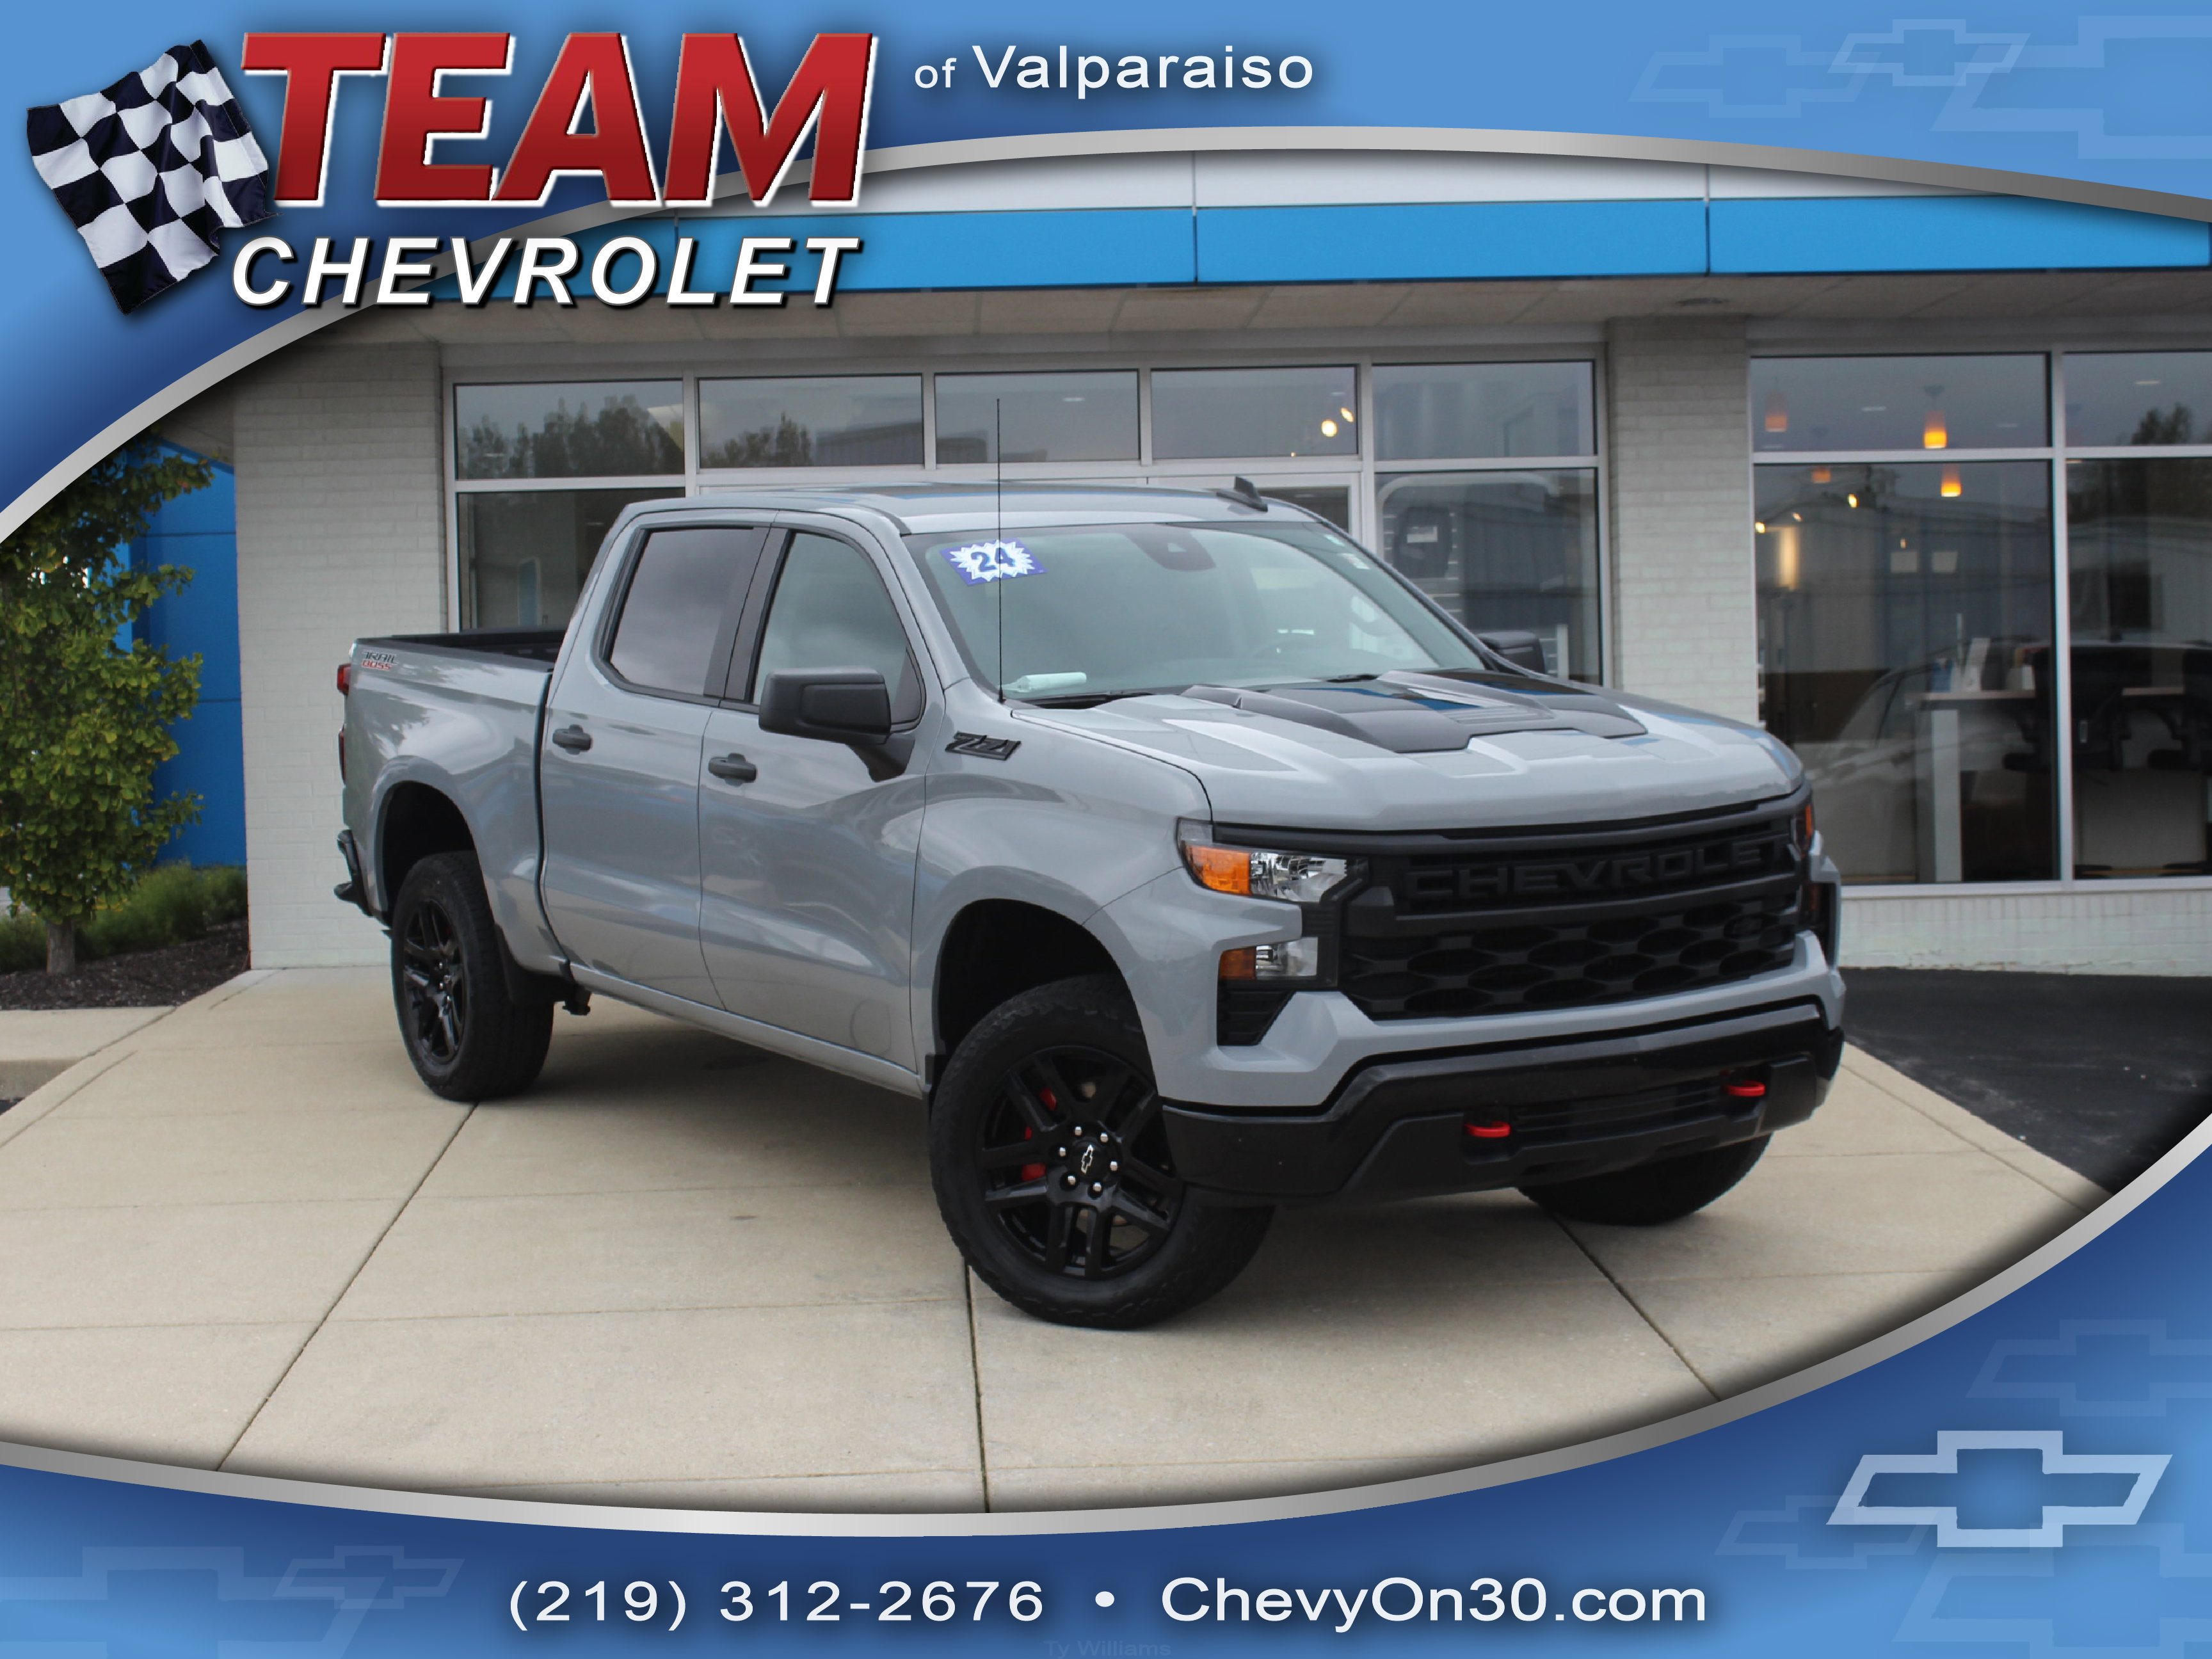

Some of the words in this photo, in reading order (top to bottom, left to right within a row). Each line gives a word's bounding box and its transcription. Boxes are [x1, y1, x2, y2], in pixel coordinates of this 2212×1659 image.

[970, 547, 1016, 572] 24
[363, 651, 399, 664] TRAIL
[1406, 833, 1790, 897] CHEVROLET
